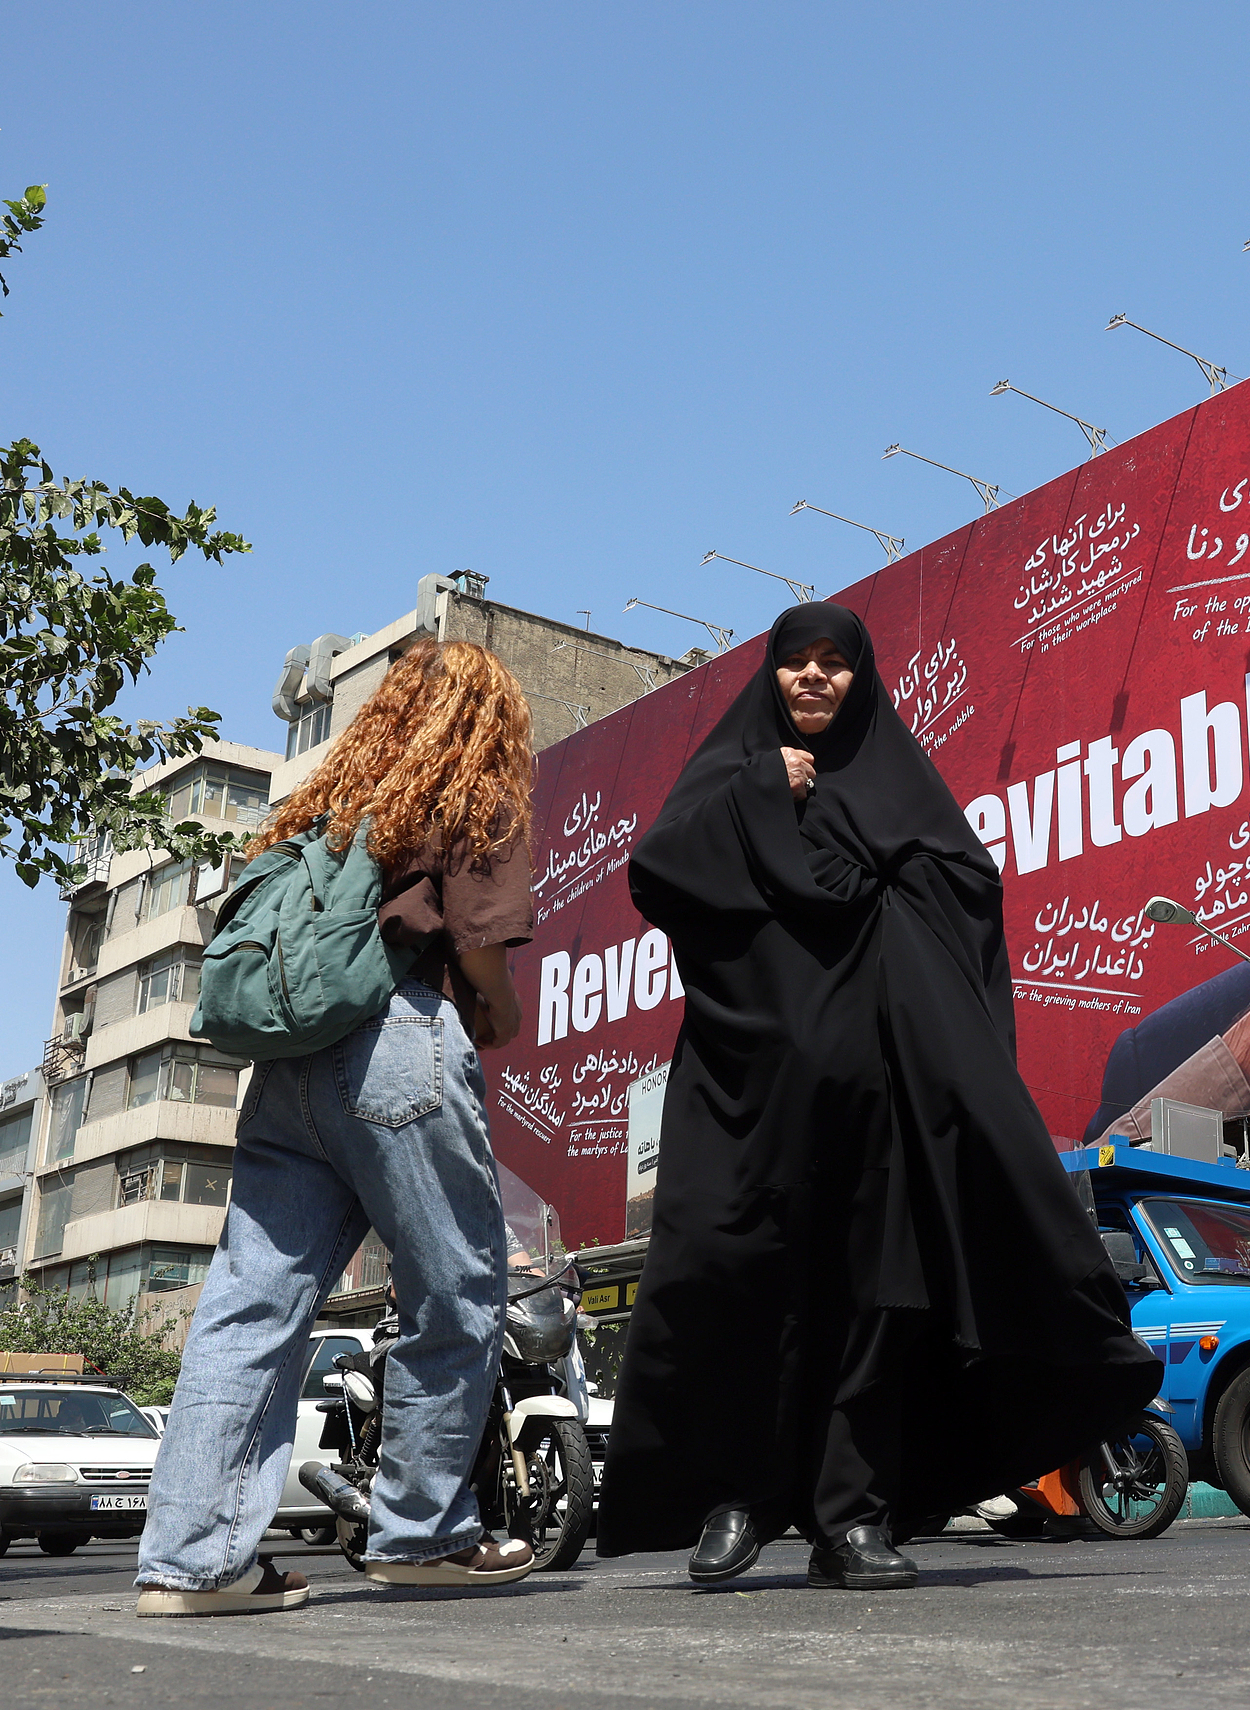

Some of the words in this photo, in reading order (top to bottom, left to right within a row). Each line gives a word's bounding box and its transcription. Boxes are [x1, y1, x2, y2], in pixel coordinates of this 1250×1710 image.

[1052, 513, 1088, 556] آنها
[1089, 502, 1126, 538] برای
[1119, 522, 1141, 550] در
[1024, 538, 1050, 572] که
[1080, 538, 1120, 573] محل
[1186, 523, 1223, 561] دنا
[1013, 551, 1080, 610] کارشان
[1077, 555, 1122, 596] شهید
[1020, 639, 1035, 653] For
[1038, 624, 1061, 642] those
[1064, 611, 1080, 627] who
[1083, 600, 1102, 616] were
[1104, 571, 1143, 606] martyred
[1027, 585, 1073, 624] شدند
[1173, 600, 1198, 621] For
[1205, 597, 1226, 615] the
[1041, 641, 1049, 654] in
[1052, 629, 1073, 647] their
[1075, 602, 1118, 633] workplace
[1192, 622, 1211, 643] of
[1216, 618, 1238, 636] the
[924, 638, 957, 679] برای
[943, 660, 967, 706] زیر
[910, 676, 938, 733] آوار
[933, 733, 948, 750] the
[949, 704, 975, 736] rubble
[563, 790, 601, 837] برای
[530, 848, 576, 897] میناب
[537, 907, 551, 925] For
[552, 899, 565, 913] the
[567, 879, 594, 904] children
[595, 869, 605, 885] of
[606, 849, 630, 876] Minab
[1034, 896, 1108, 936] مادران
[1195, 890, 1248, 923] ماهه
[1110, 907, 1157, 947] برای
[1022, 937, 1079, 978] ایران
[1074, 942, 1145, 981] داغدار
[1195, 942, 1209, 955] For
[1012, 986, 1028, 999] For
[1029, 988, 1042, 1002] the
[1044, 993, 1076, 1011] grieving
[1078, 997, 1111, 1012] mothers
[1112, 1000, 1123, 1014] of
[1124, 1002, 1141, 1015] Iran
[501, 1065, 531, 1093] شهید
[540, 1063, 562, 1094] برای
[572, 1049, 638, 1084] دادخواهی
[642, 1070, 667, 1095] HONOR
[524, 1087, 566, 1128] امدادگران
[571, 1083, 612, 1116] لامرد
[497, 1095, 507, 1110] For
[506, 1102, 514, 1115] the
[513, 1110, 535, 1132] martyred
[533, 1125, 552, 1144] rescuers
[569, 1129, 582, 1142] For
[585, 1127, 597, 1140] the
[598, 1127, 623, 1143] justice
[567, 1144, 579, 1157] the
[581, 1143, 608, 1158] martyrs
[609, 1142, 619, 1155] of
[587, 1295, 599, 1306] Vali
[599, 1294, 611, 1303] Asr
[99, 1497, 113, 1508] ۸۸
[115, 1497, 124, 1508] ج
[127, 1497, 146, 1508] ۱۶۸
